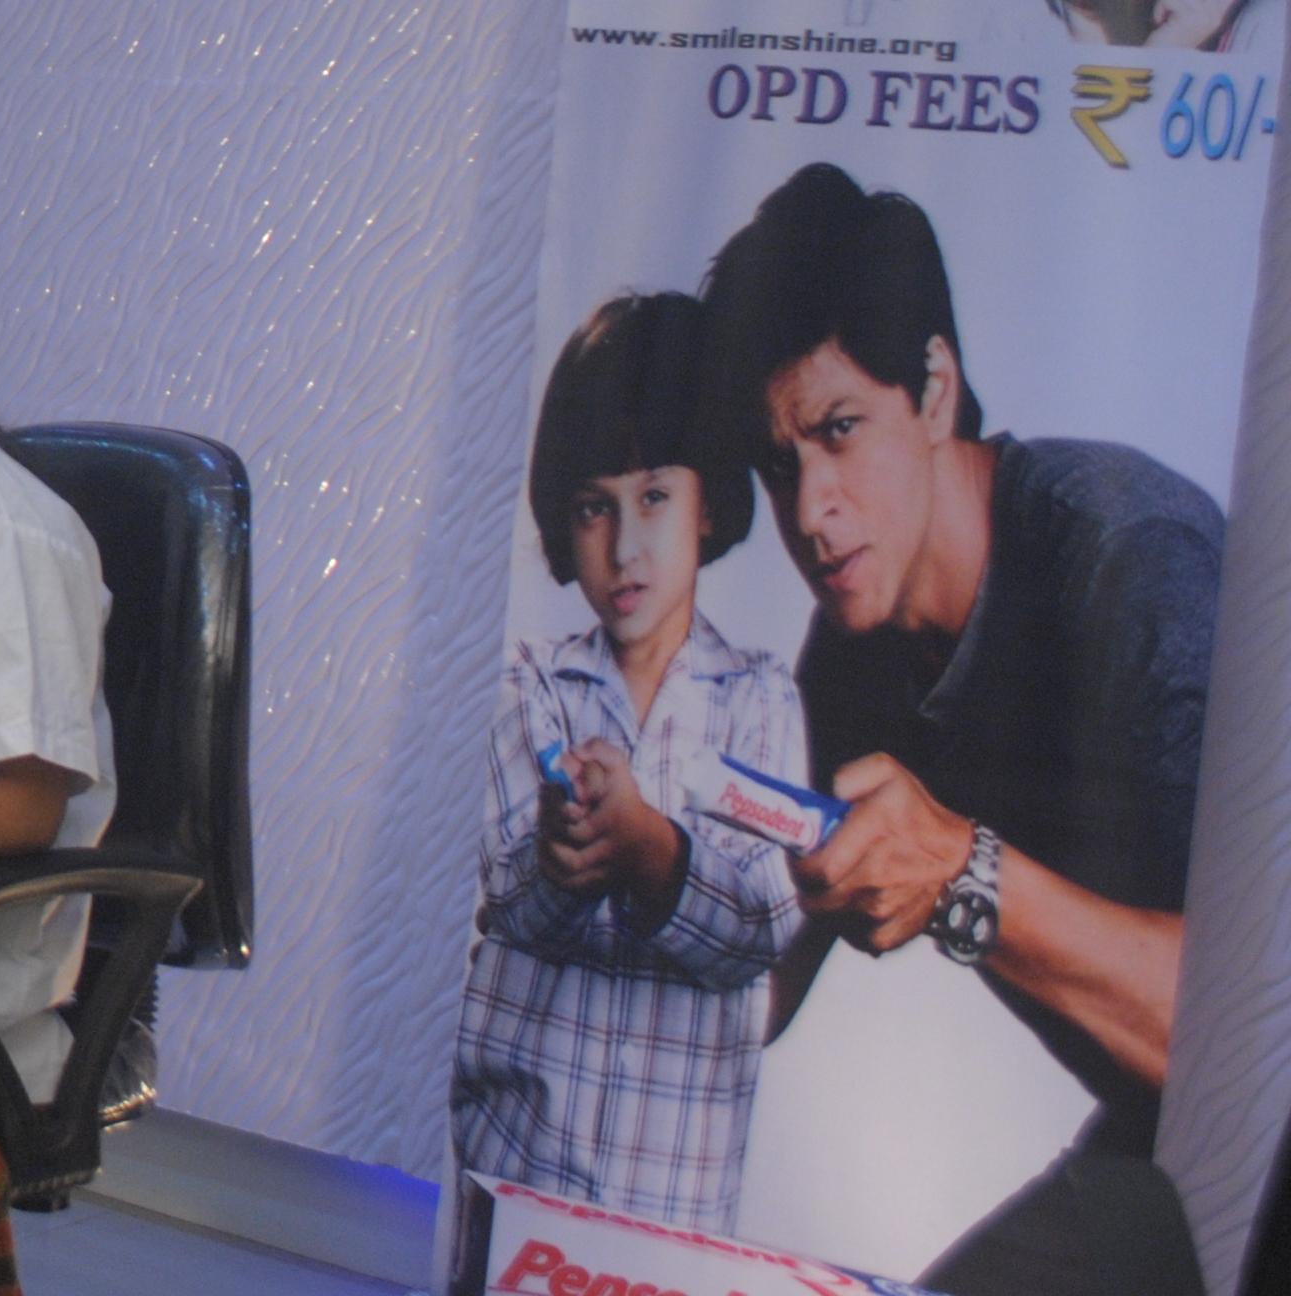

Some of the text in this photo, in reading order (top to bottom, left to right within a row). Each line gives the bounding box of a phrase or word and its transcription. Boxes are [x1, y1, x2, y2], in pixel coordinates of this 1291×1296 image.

[572, 26, 957, 61] www.smilenshine.org
[708, 63, 848, 125] OPD
[865, 71, 1040, 134] FEES
[1160, 73, 1276, 160] 60/-
[718, 782, 805, 838] Pepsodent
